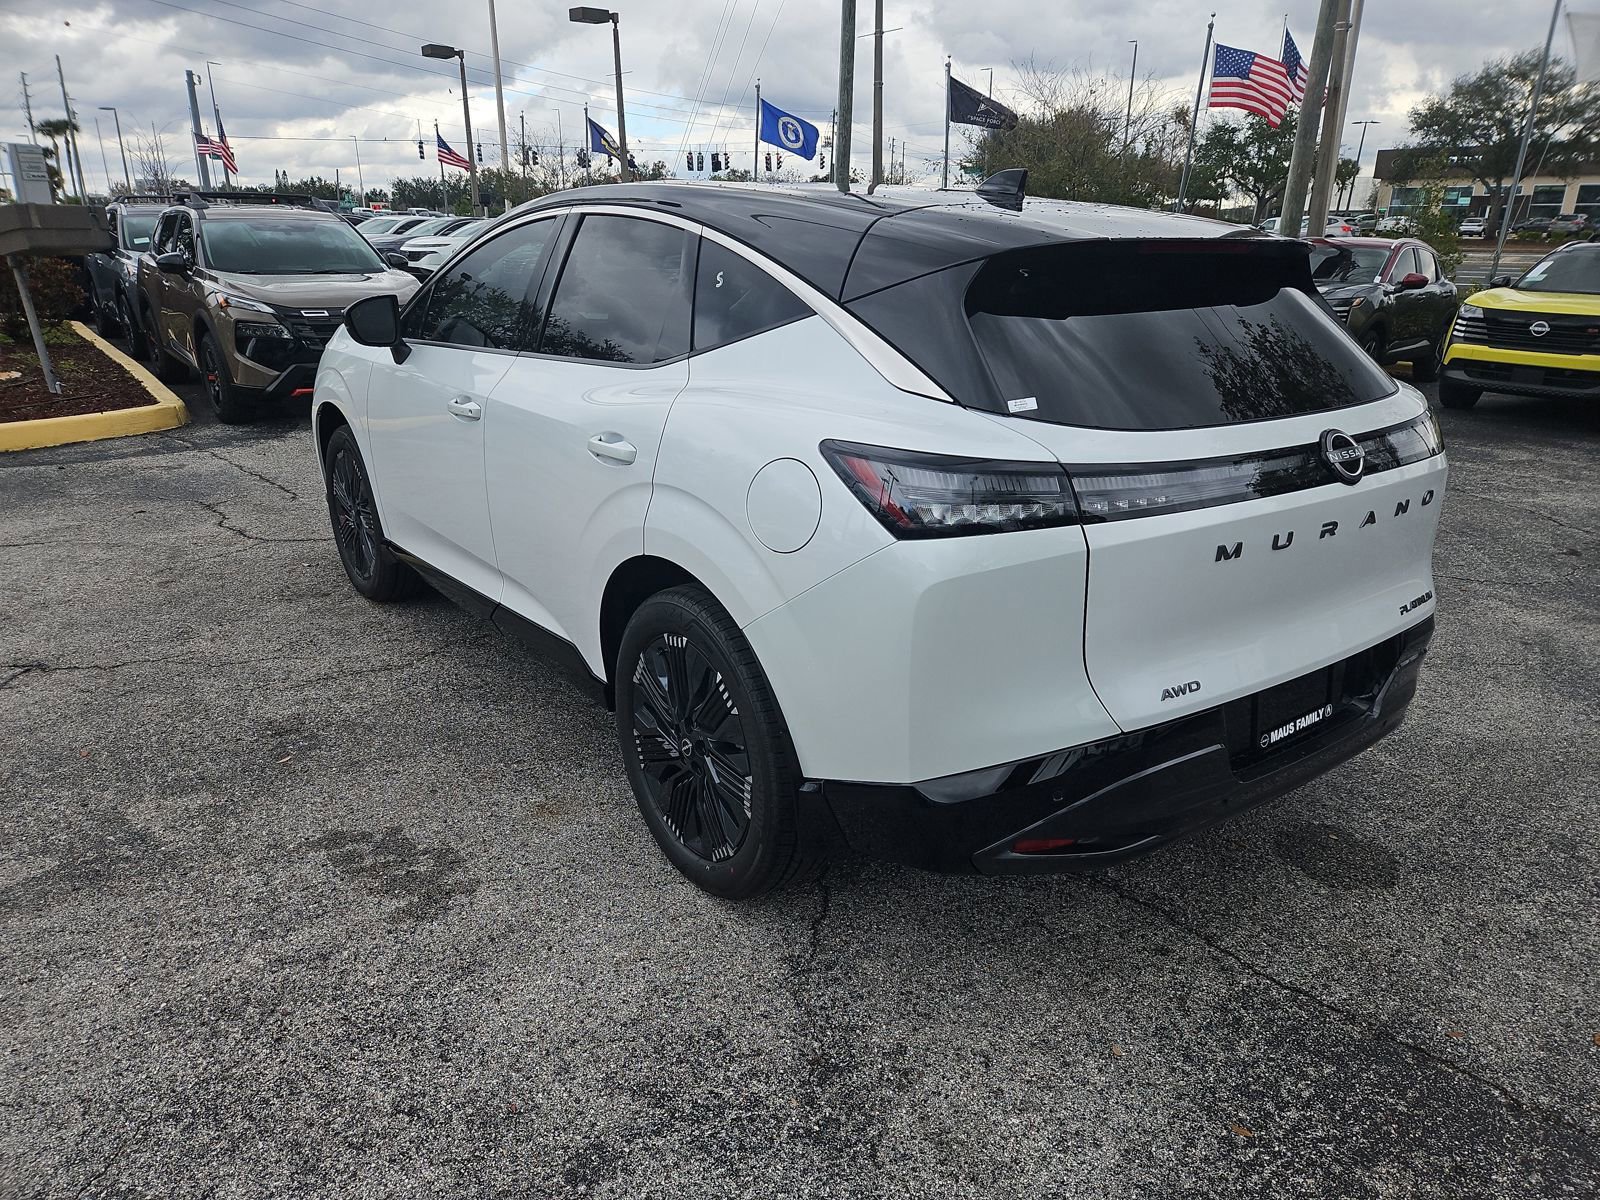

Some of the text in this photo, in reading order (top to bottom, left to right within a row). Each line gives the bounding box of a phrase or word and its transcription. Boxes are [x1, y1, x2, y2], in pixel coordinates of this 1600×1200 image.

[1215, 489, 1435, 562] MURANO
[1160, 680, 1202, 702] AWD
[1270, 707, 1325, 744] MAUS FAMILY
